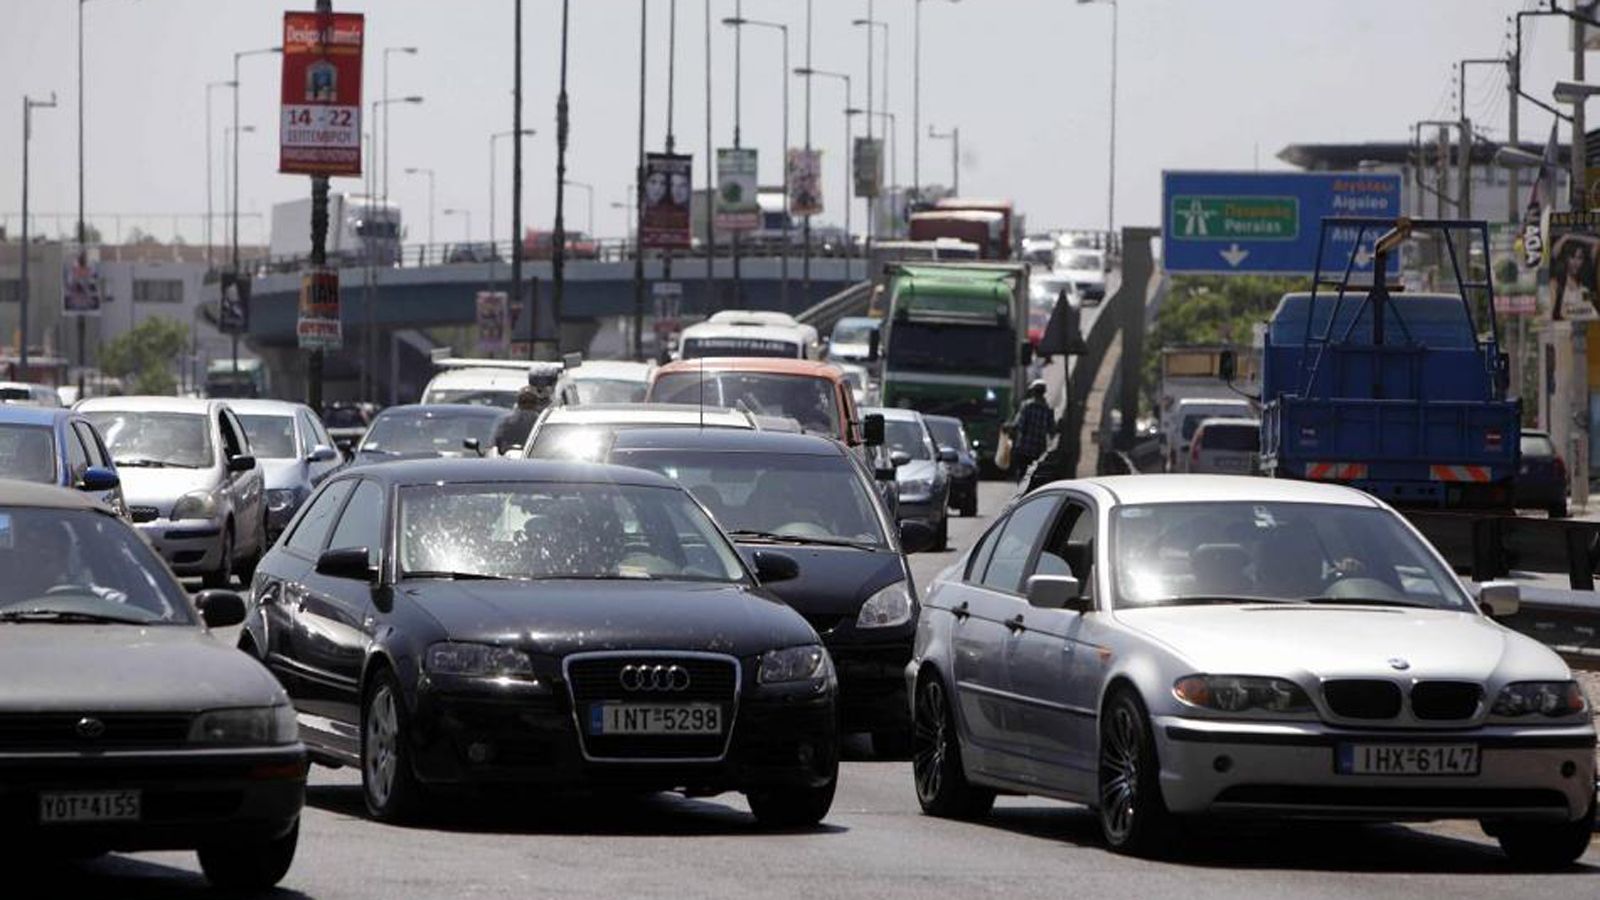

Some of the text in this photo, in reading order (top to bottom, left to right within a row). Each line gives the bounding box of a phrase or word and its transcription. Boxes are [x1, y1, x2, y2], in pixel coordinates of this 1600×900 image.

[289, 109, 312, 125] 14
[330, 110, 351, 127] 22
[1332, 194, 1389, 210] Aigaleo
